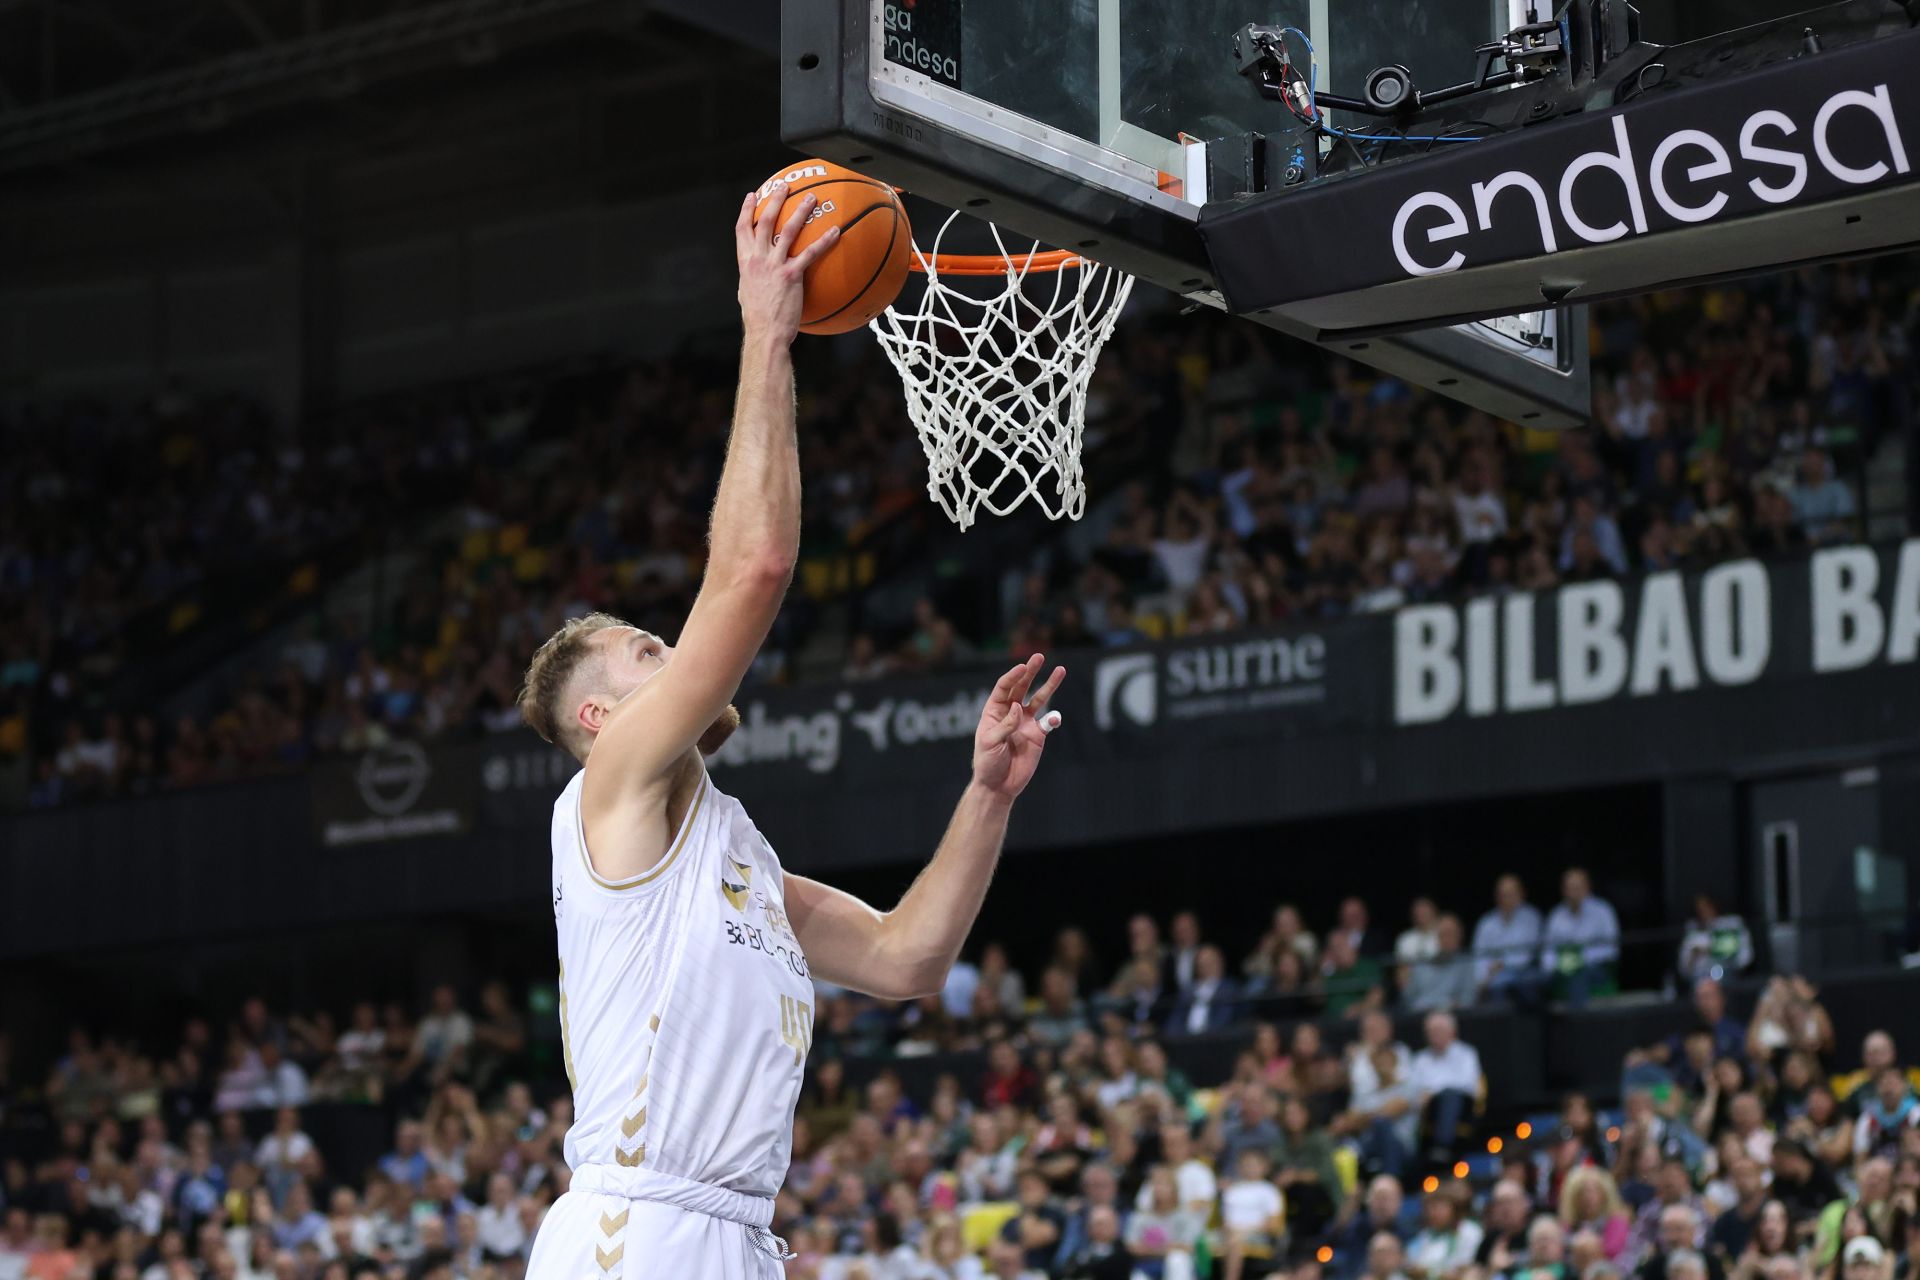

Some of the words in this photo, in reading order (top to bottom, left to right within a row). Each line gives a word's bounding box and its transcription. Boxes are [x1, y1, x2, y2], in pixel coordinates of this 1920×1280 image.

[1392, 84, 1910, 277] endesa
[1167, 634, 1325, 696] surne
[1395, 558, 1771, 725] BILBAO
